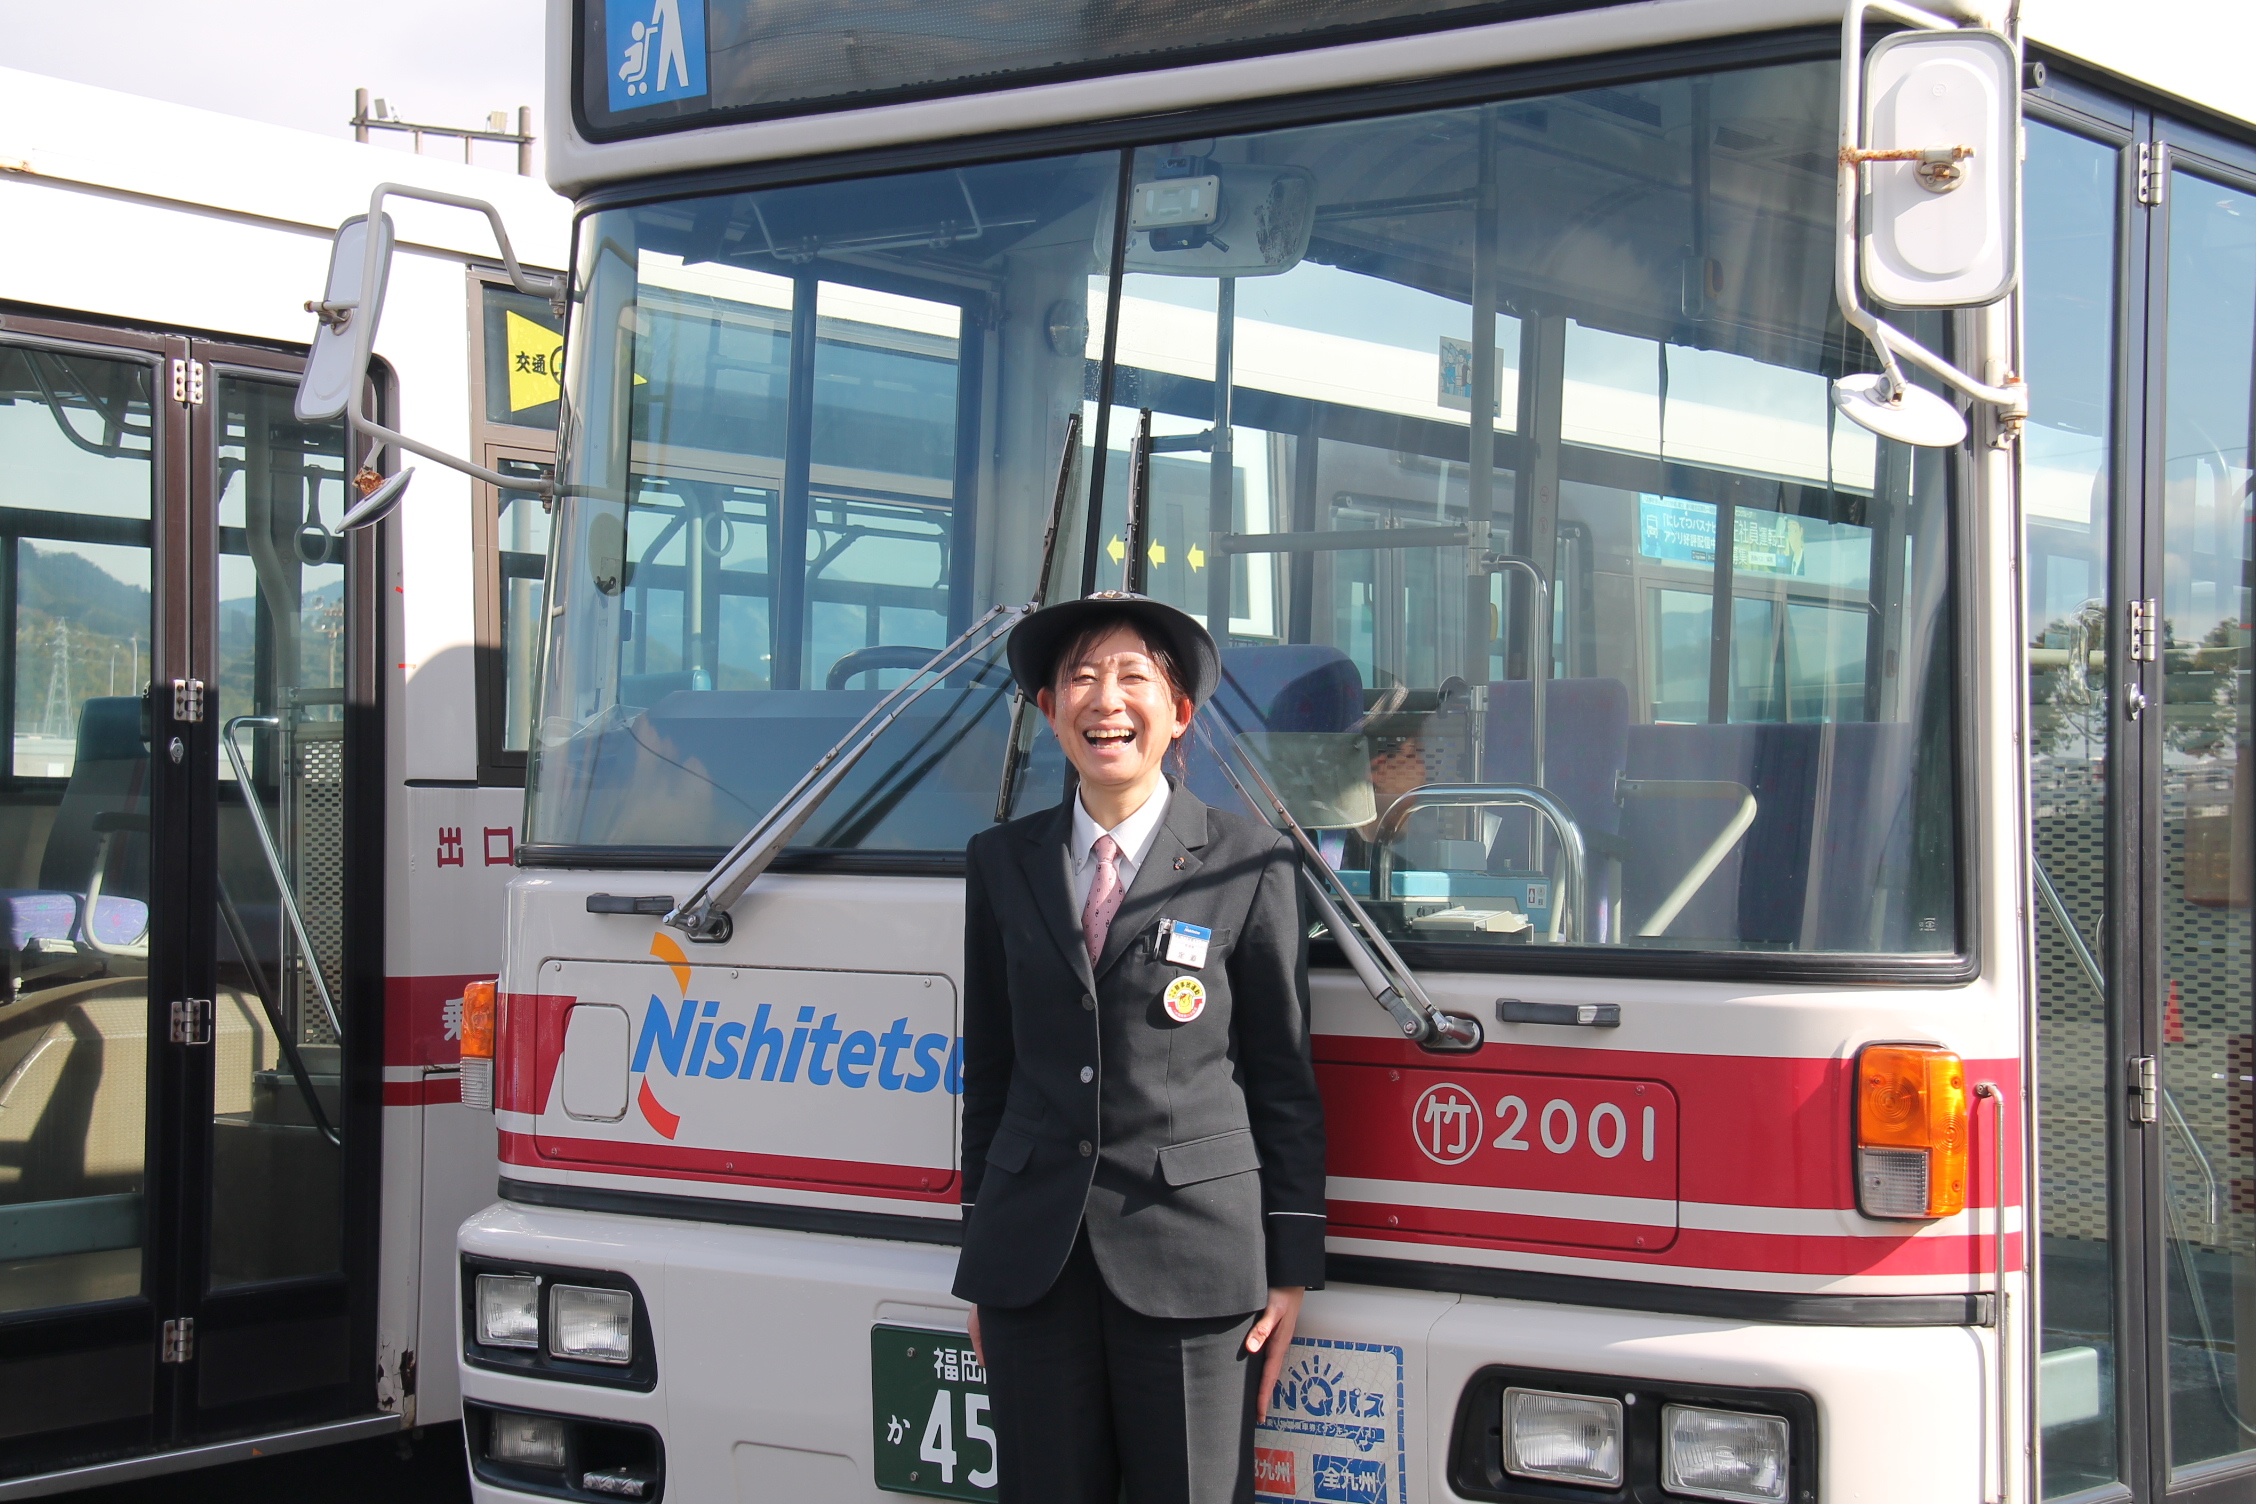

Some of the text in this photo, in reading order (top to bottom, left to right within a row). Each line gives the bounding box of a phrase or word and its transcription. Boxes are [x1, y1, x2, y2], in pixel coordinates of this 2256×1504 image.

[515, 350, 548, 376] 交通
[437, 826, 514, 868] 出口
[1420, 1091, 1656, 1162] 竹 2001
[887, 1388, 999, 1490] か 45
[1322, 1466, 1378, 1494] 全九州
